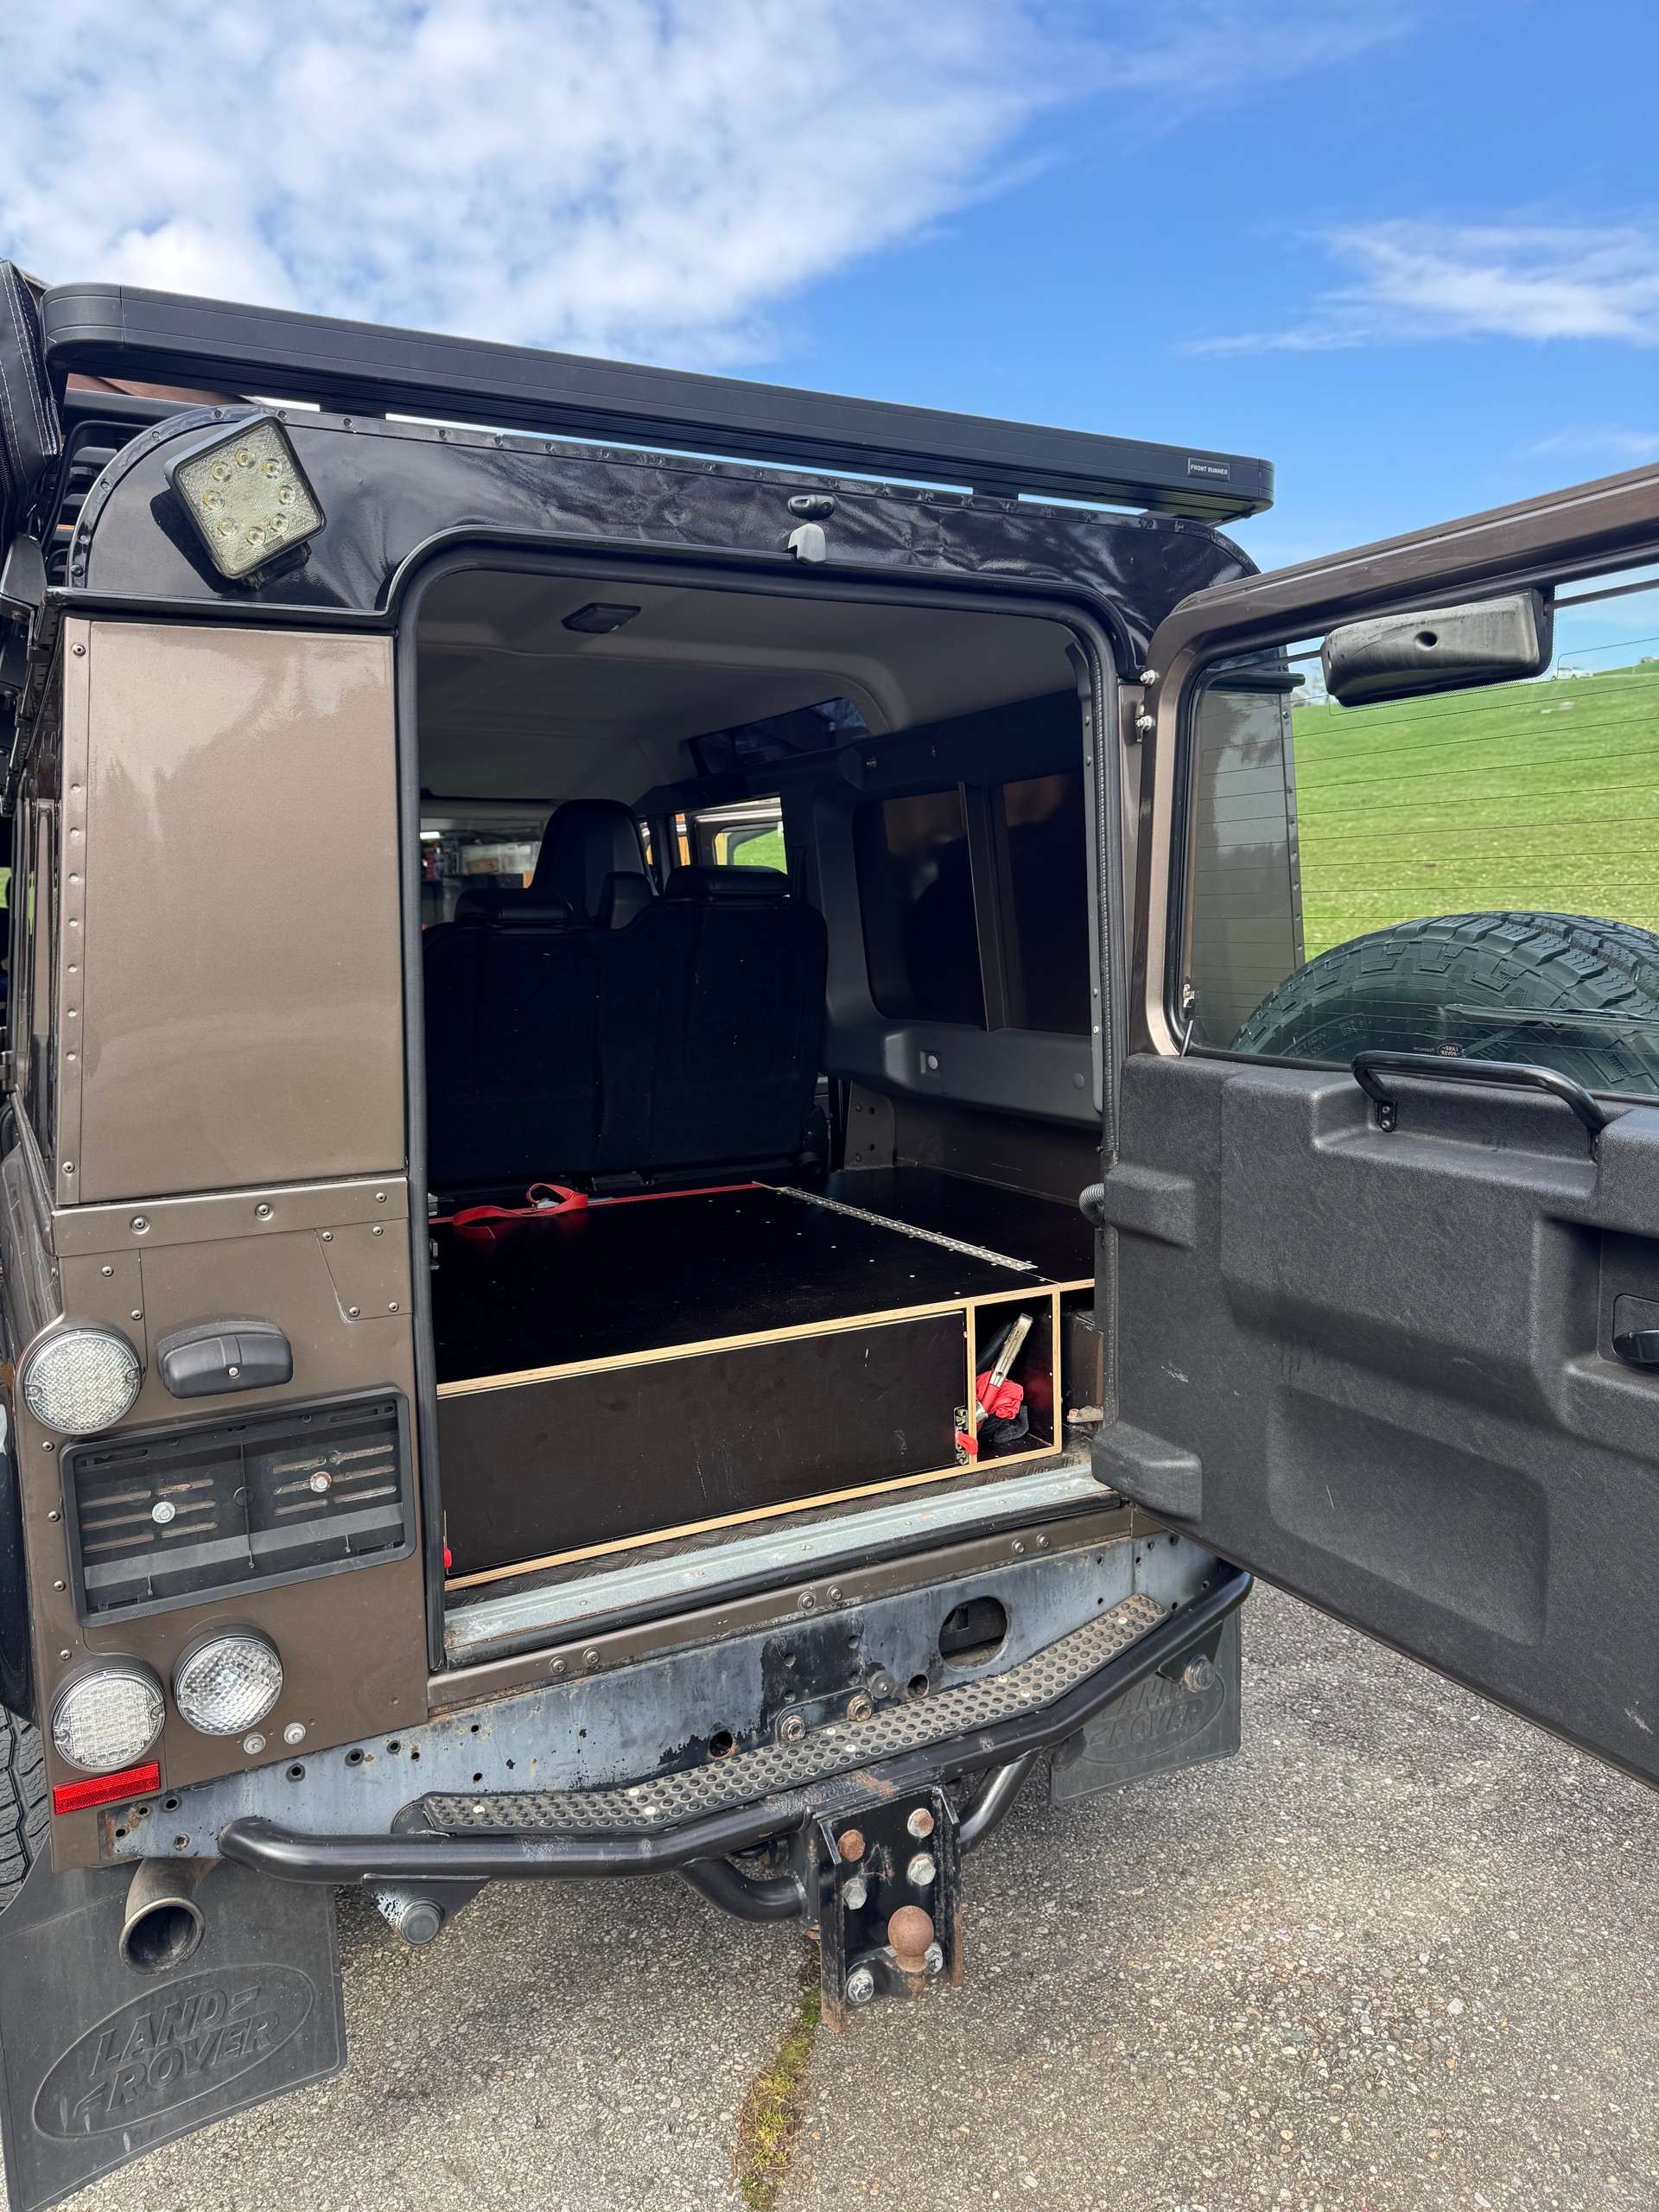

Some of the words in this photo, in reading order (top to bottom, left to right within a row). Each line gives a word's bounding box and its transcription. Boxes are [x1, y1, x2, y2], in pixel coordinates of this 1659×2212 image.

[1190, 464, 1207, 473] FRONT
[1207, 467, 1228, 475] RUNNER
[1107, 1698, 1204, 1750] ROVER
[89, 1988, 228, 2077] LAND
[105, 2010, 280, 2113] ROVER
